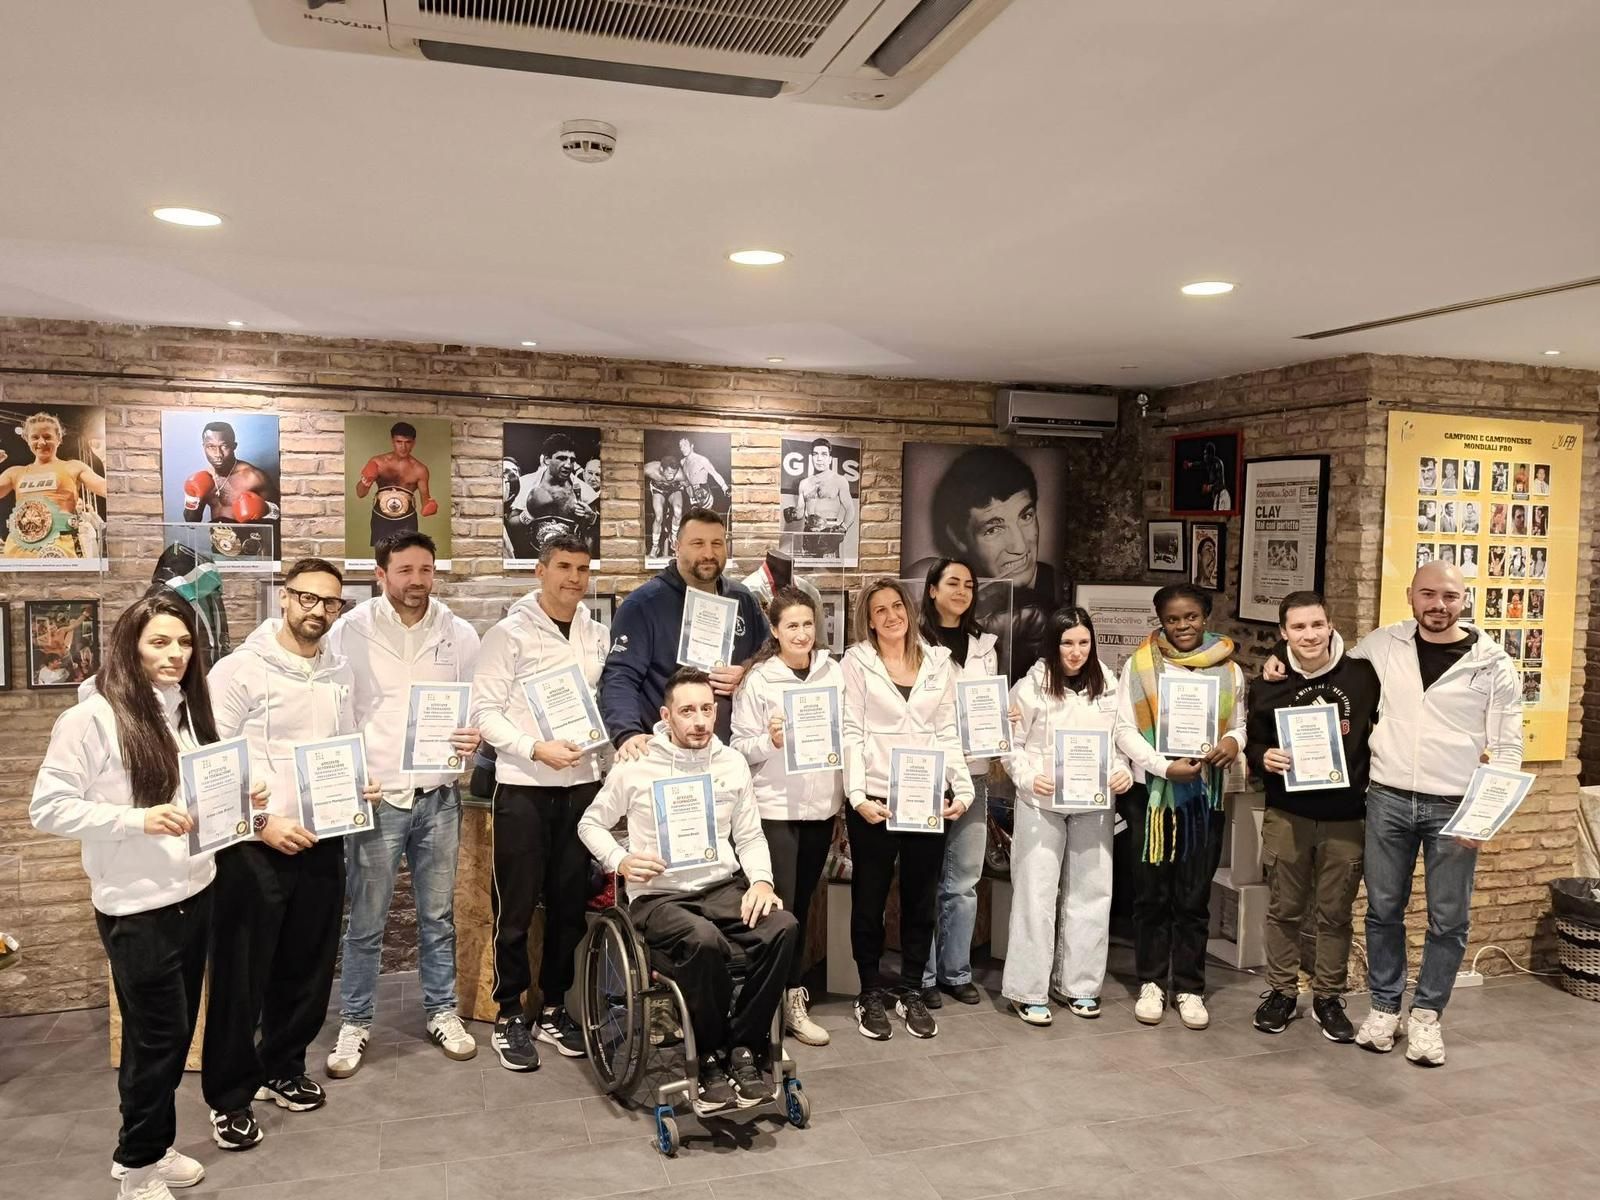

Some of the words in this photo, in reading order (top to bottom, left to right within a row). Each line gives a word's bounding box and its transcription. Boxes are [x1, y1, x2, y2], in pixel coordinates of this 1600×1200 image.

[304, 13, 382, 31] HITACHI
[1444, 432, 1479, 442] CAMPIONI
[1485, 435, 1532, 445] CAMPIONESSE
[1463, 442, 1498, 451] MONDIALI
[1255, 505, 1281, 518] CLAY
